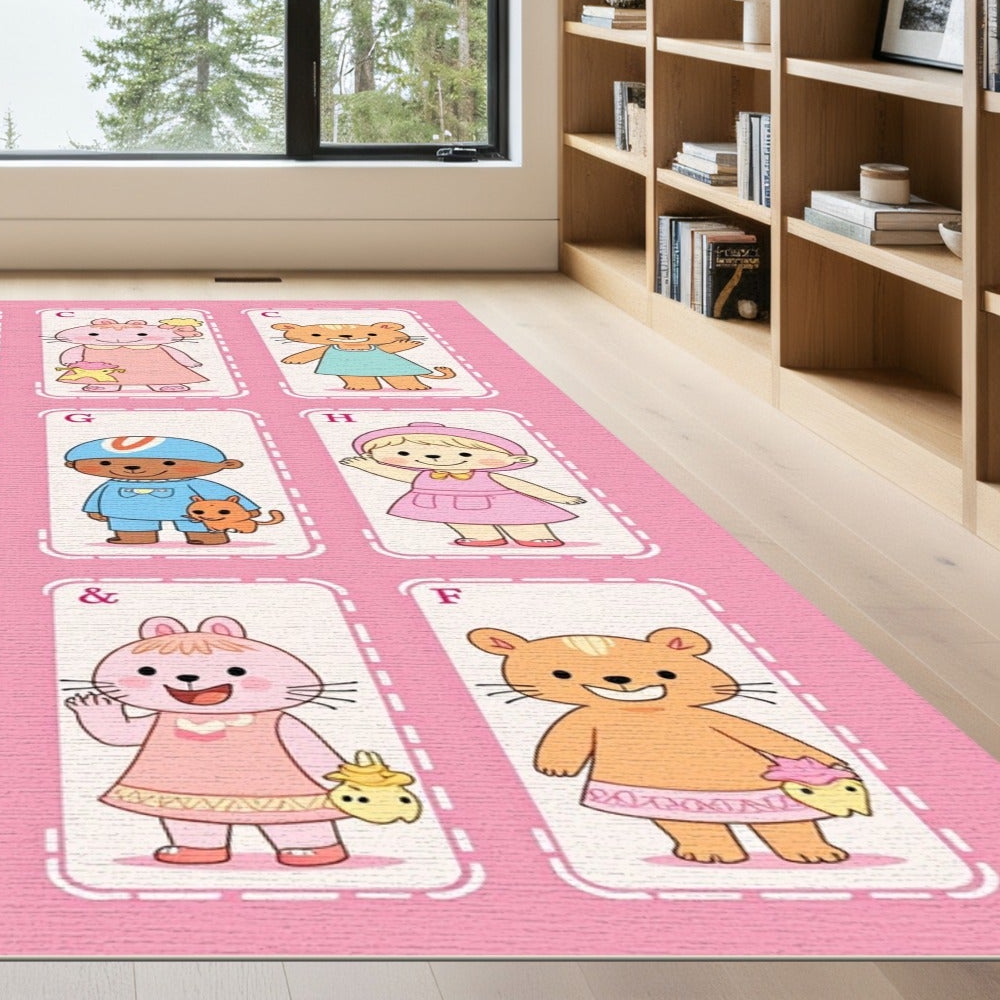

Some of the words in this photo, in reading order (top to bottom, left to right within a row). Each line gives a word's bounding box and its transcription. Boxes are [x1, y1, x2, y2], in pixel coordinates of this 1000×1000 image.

[64, 413, 95, 423] G
[322, 413, 358, 423] H
[78, 587, 119, 604] &
[429, 587, 462, 604] F
